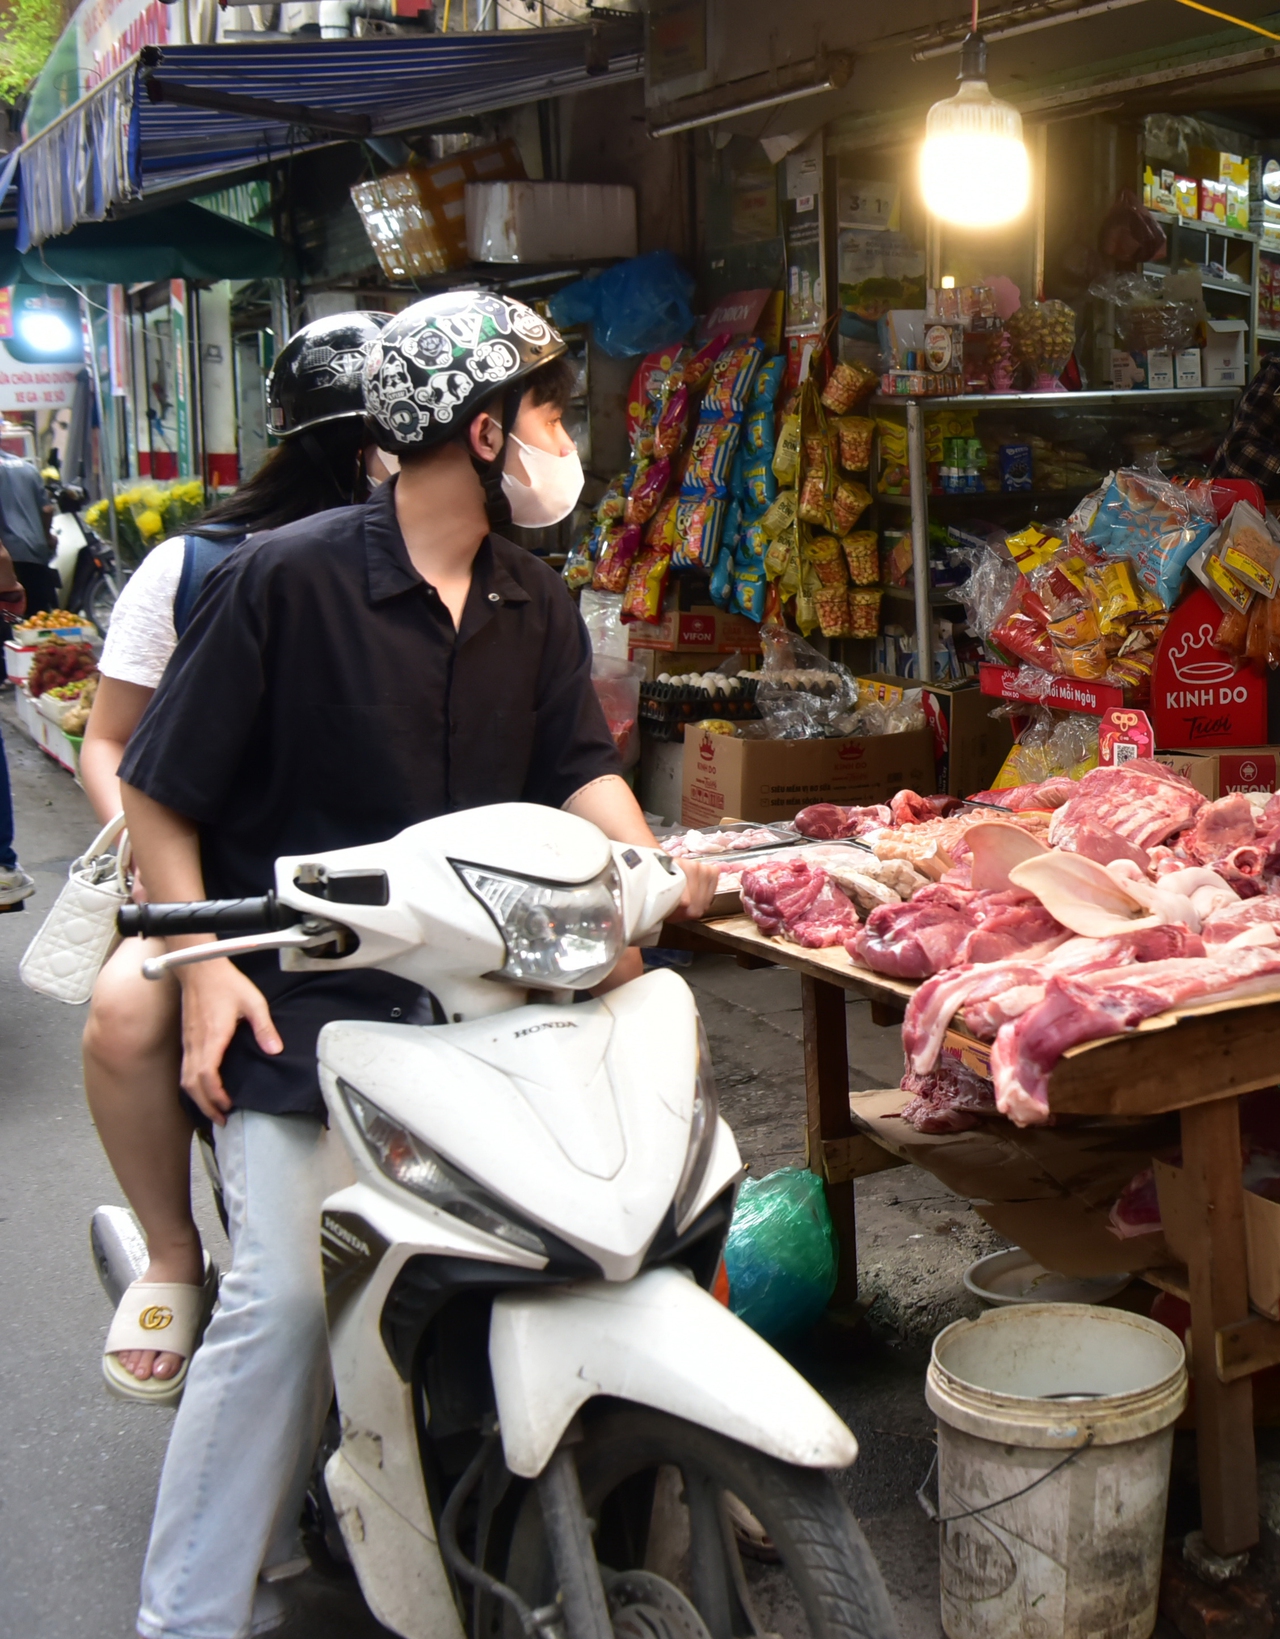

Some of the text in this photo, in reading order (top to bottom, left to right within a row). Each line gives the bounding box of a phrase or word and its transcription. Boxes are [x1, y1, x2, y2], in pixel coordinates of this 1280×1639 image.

[683, 632, 711, 641] VIFON
[1001, 690, 1013, 698] KINH
[1060, 683, 1074, 700] Mỗi
[1075, 689, 1096, 708] Ngày
[1166, 686, 1248, 709] KINH DO
[1182, 714, 1233, 741] Tươi
[697, 762, 717, 775] KINH DO
[834, 761, 867, 771] KINH DO
[771, 785, 785, 794] SIÊU
[802, 786, 809, 795] VỊ
[771, 797, 785, 806] SIÊU
[514, 1020, 578, 1039] HONDA
[324, 1216, 371, 1257] HONDA
